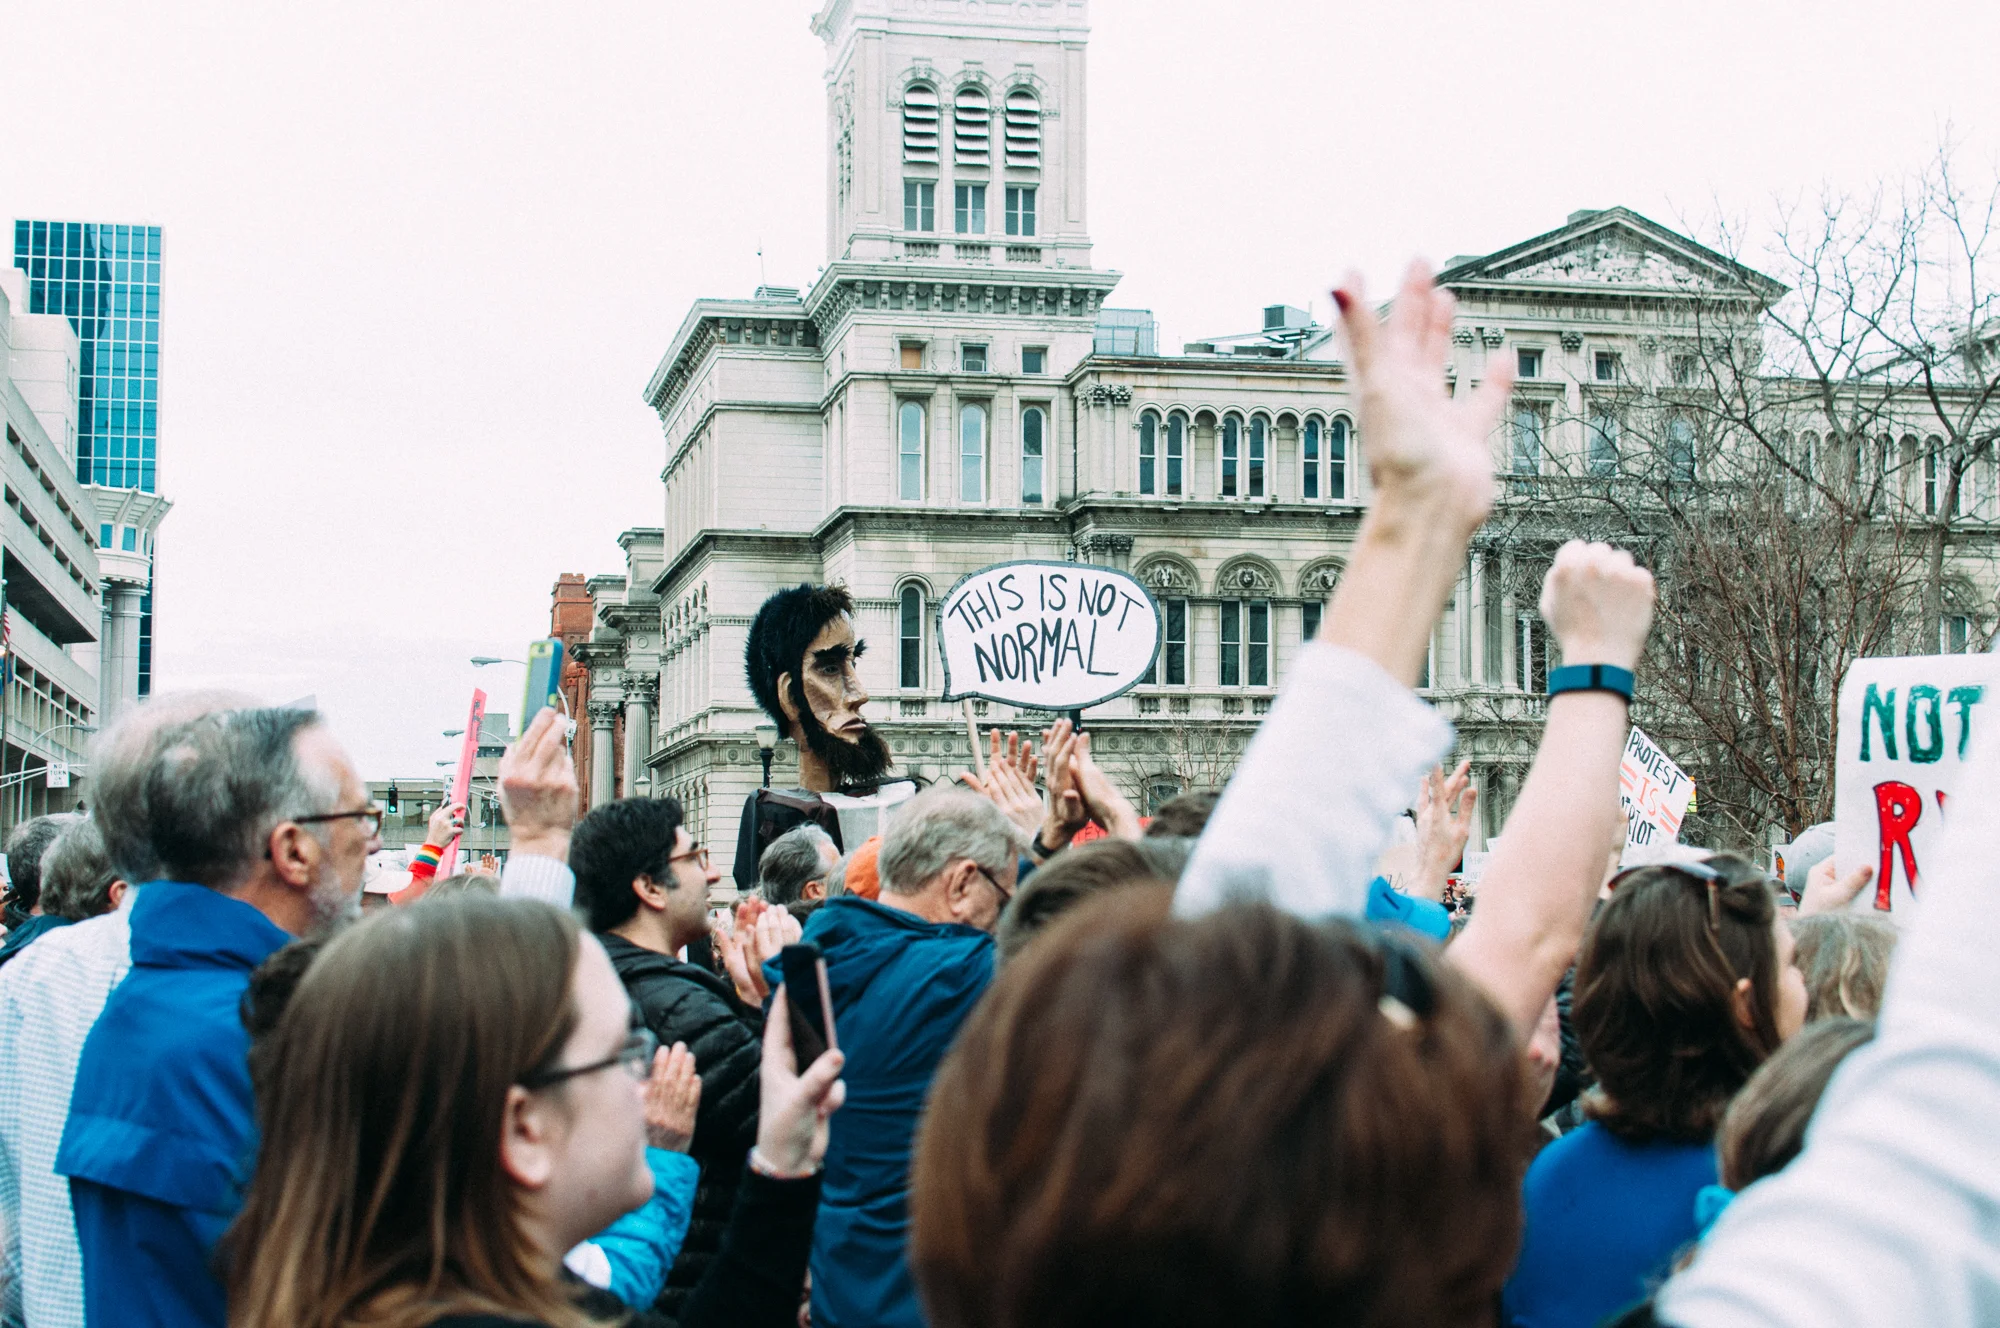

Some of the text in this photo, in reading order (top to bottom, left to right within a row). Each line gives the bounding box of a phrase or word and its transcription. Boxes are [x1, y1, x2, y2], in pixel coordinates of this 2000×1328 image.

[1526, 305, 1562, 318] CITY
[1572, 306, 1612, 321] HALL
[948, 573, 1145, 633] THIS IS NOT
[974, 617, 1119, 684] NORMAL
[1859, 683, 1986, 764] NOT
[1628, 731, 1687, 794] PROTEST
[1636, 776, 1659, 817] IS
